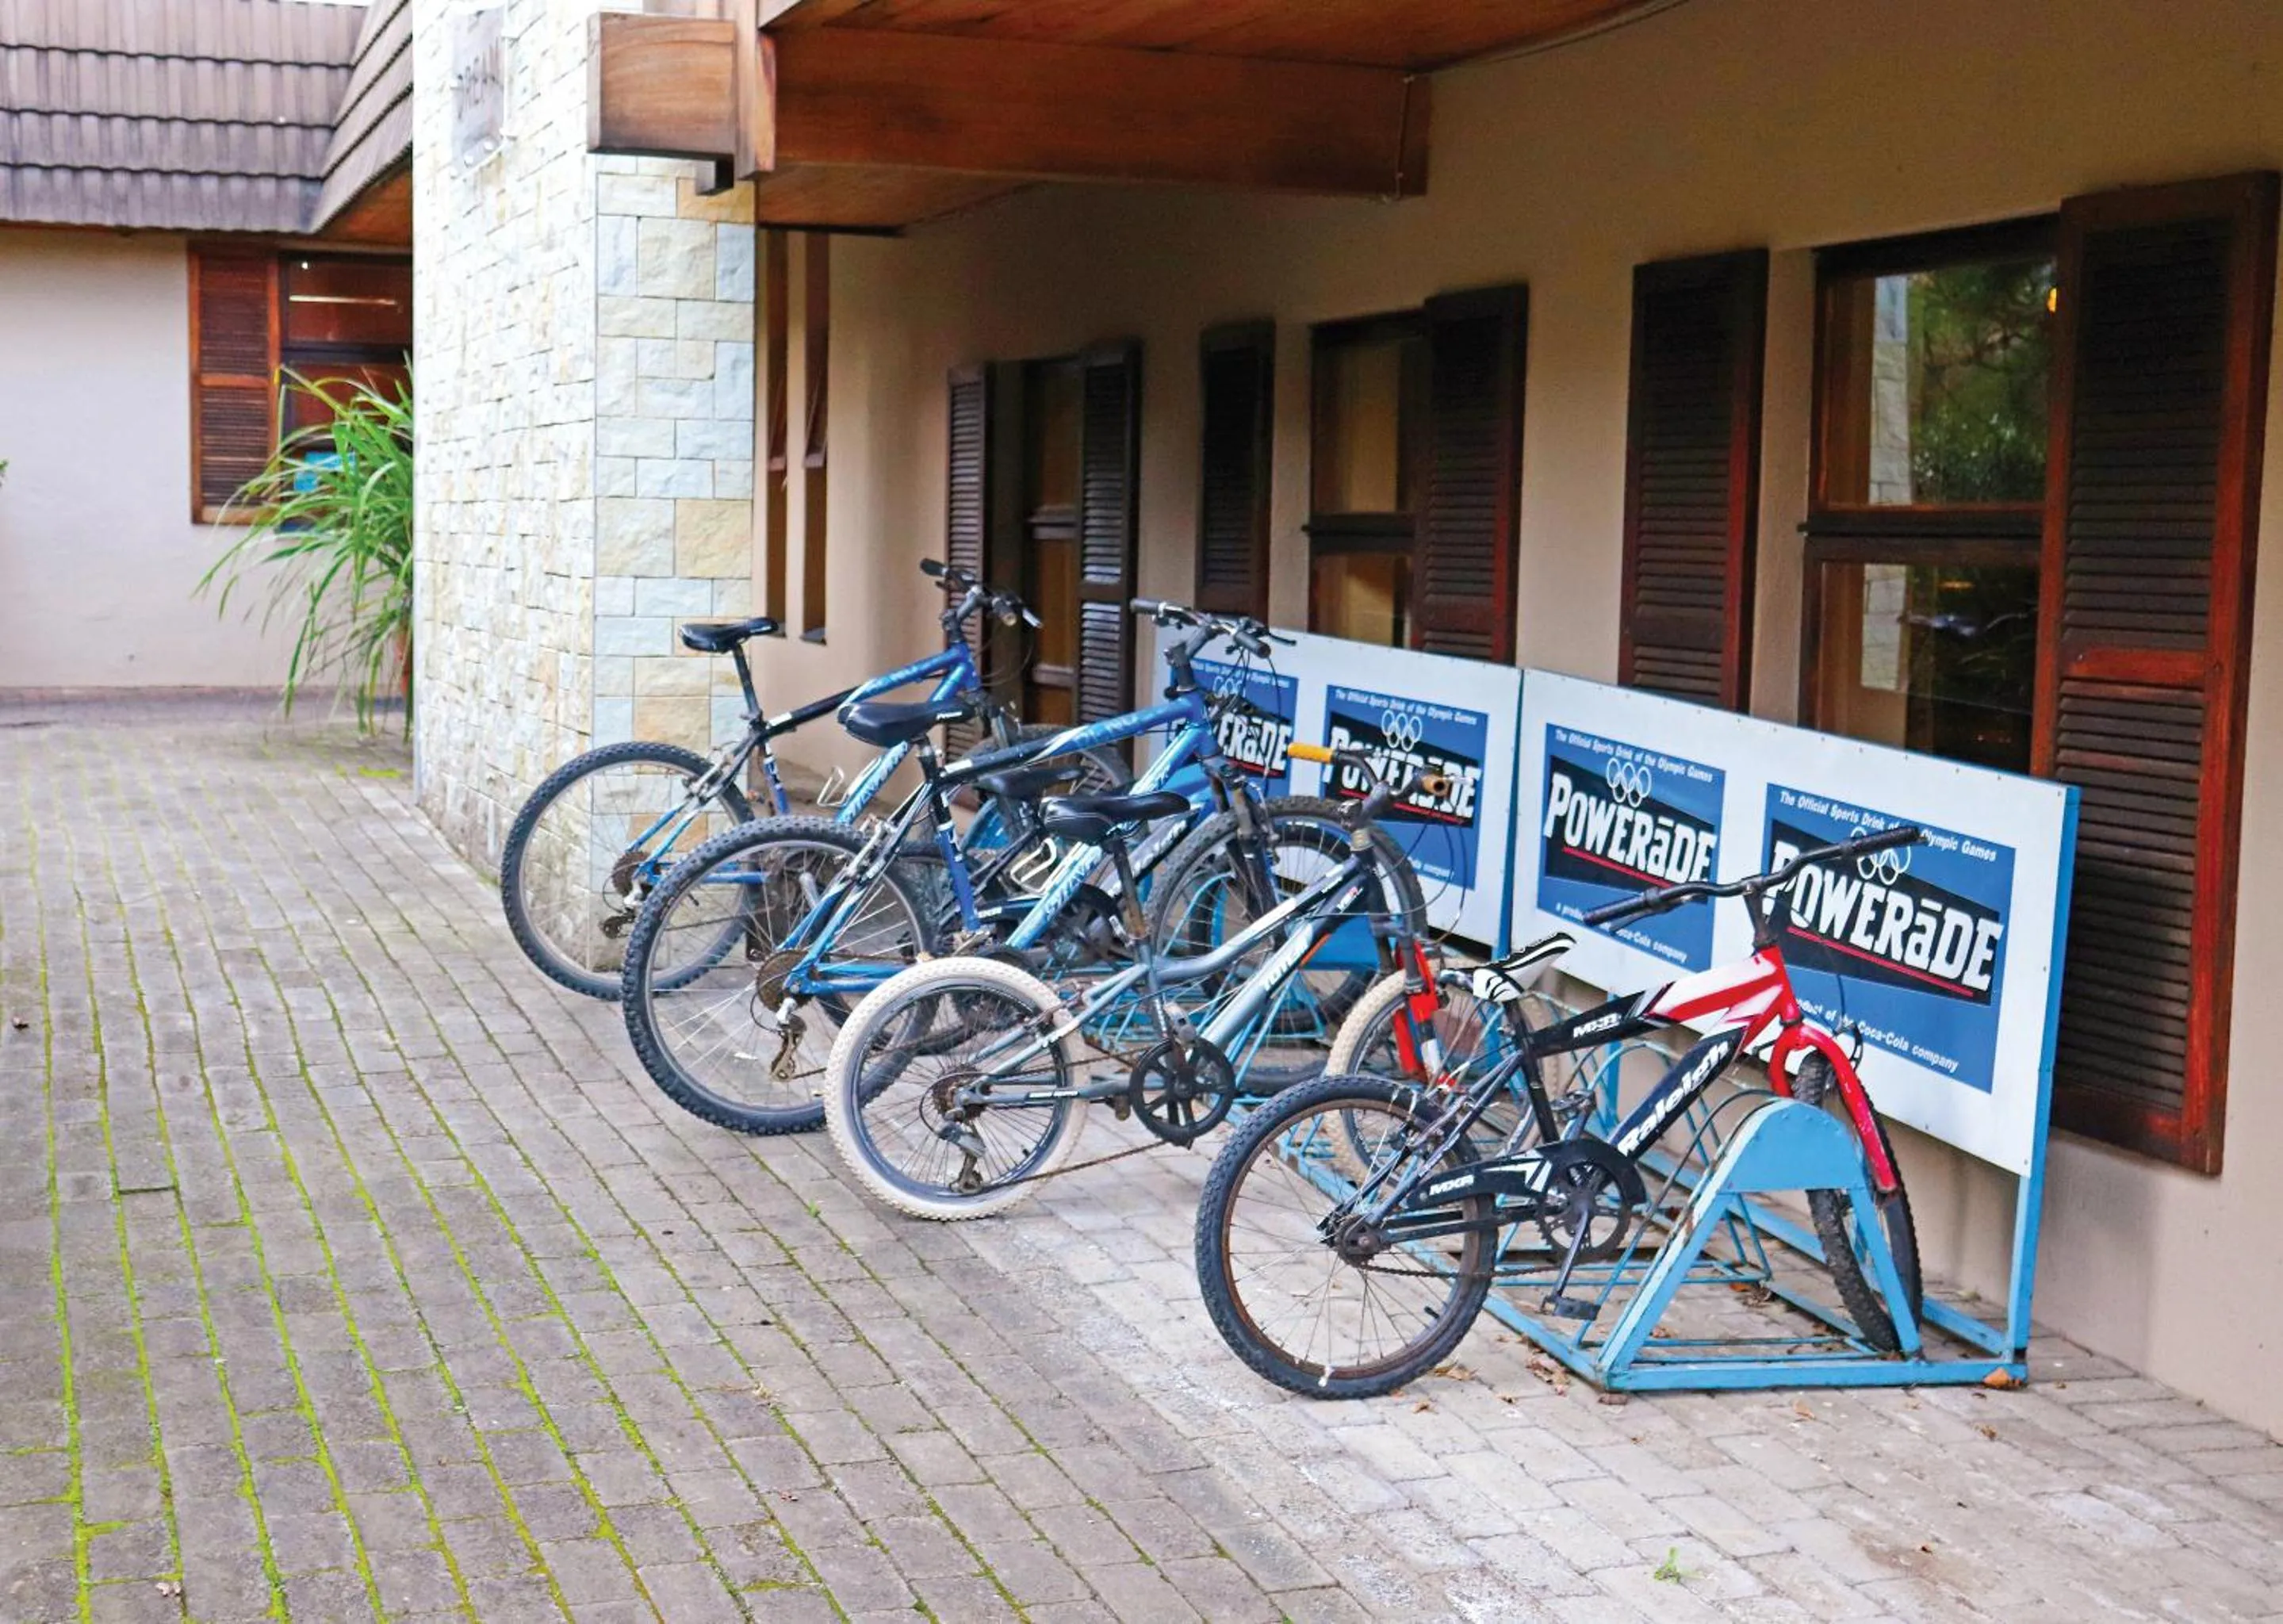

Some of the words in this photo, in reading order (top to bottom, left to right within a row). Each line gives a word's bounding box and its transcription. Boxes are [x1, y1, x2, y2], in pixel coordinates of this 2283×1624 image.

[1556, 728, 1567, 742] The
[1569, 733, 1592, 749] Official
[1592, 738, 1614, 755] Sports
[1616, 745, 1634, 760] Drink
[1634, 752, 1644, 763] of
[1645, 754, 1656, 767] the
[1657, 756, 1686, 776] Olympic
[1687, 765, 1713, 783] Games
[1543, 772, 1718, 883] POWERāDE
[1780, 791, 1795, 806] The
[1798, 795, 1829, 815] Official
[1830, 804, 1860, 823] Sports
[1861, 813, 1885, 830] Drink
[1961, 840, 1997, 862] Games
[1653, 940, 1687, 964] company
[1825, 1009, 1837, 1022] of
[1857, 1020, 1909, 1051] Coca-Cola
[1912, 1045, 1959, 1074] company
[1617, 1040, 1730, 1157] Raleigh
